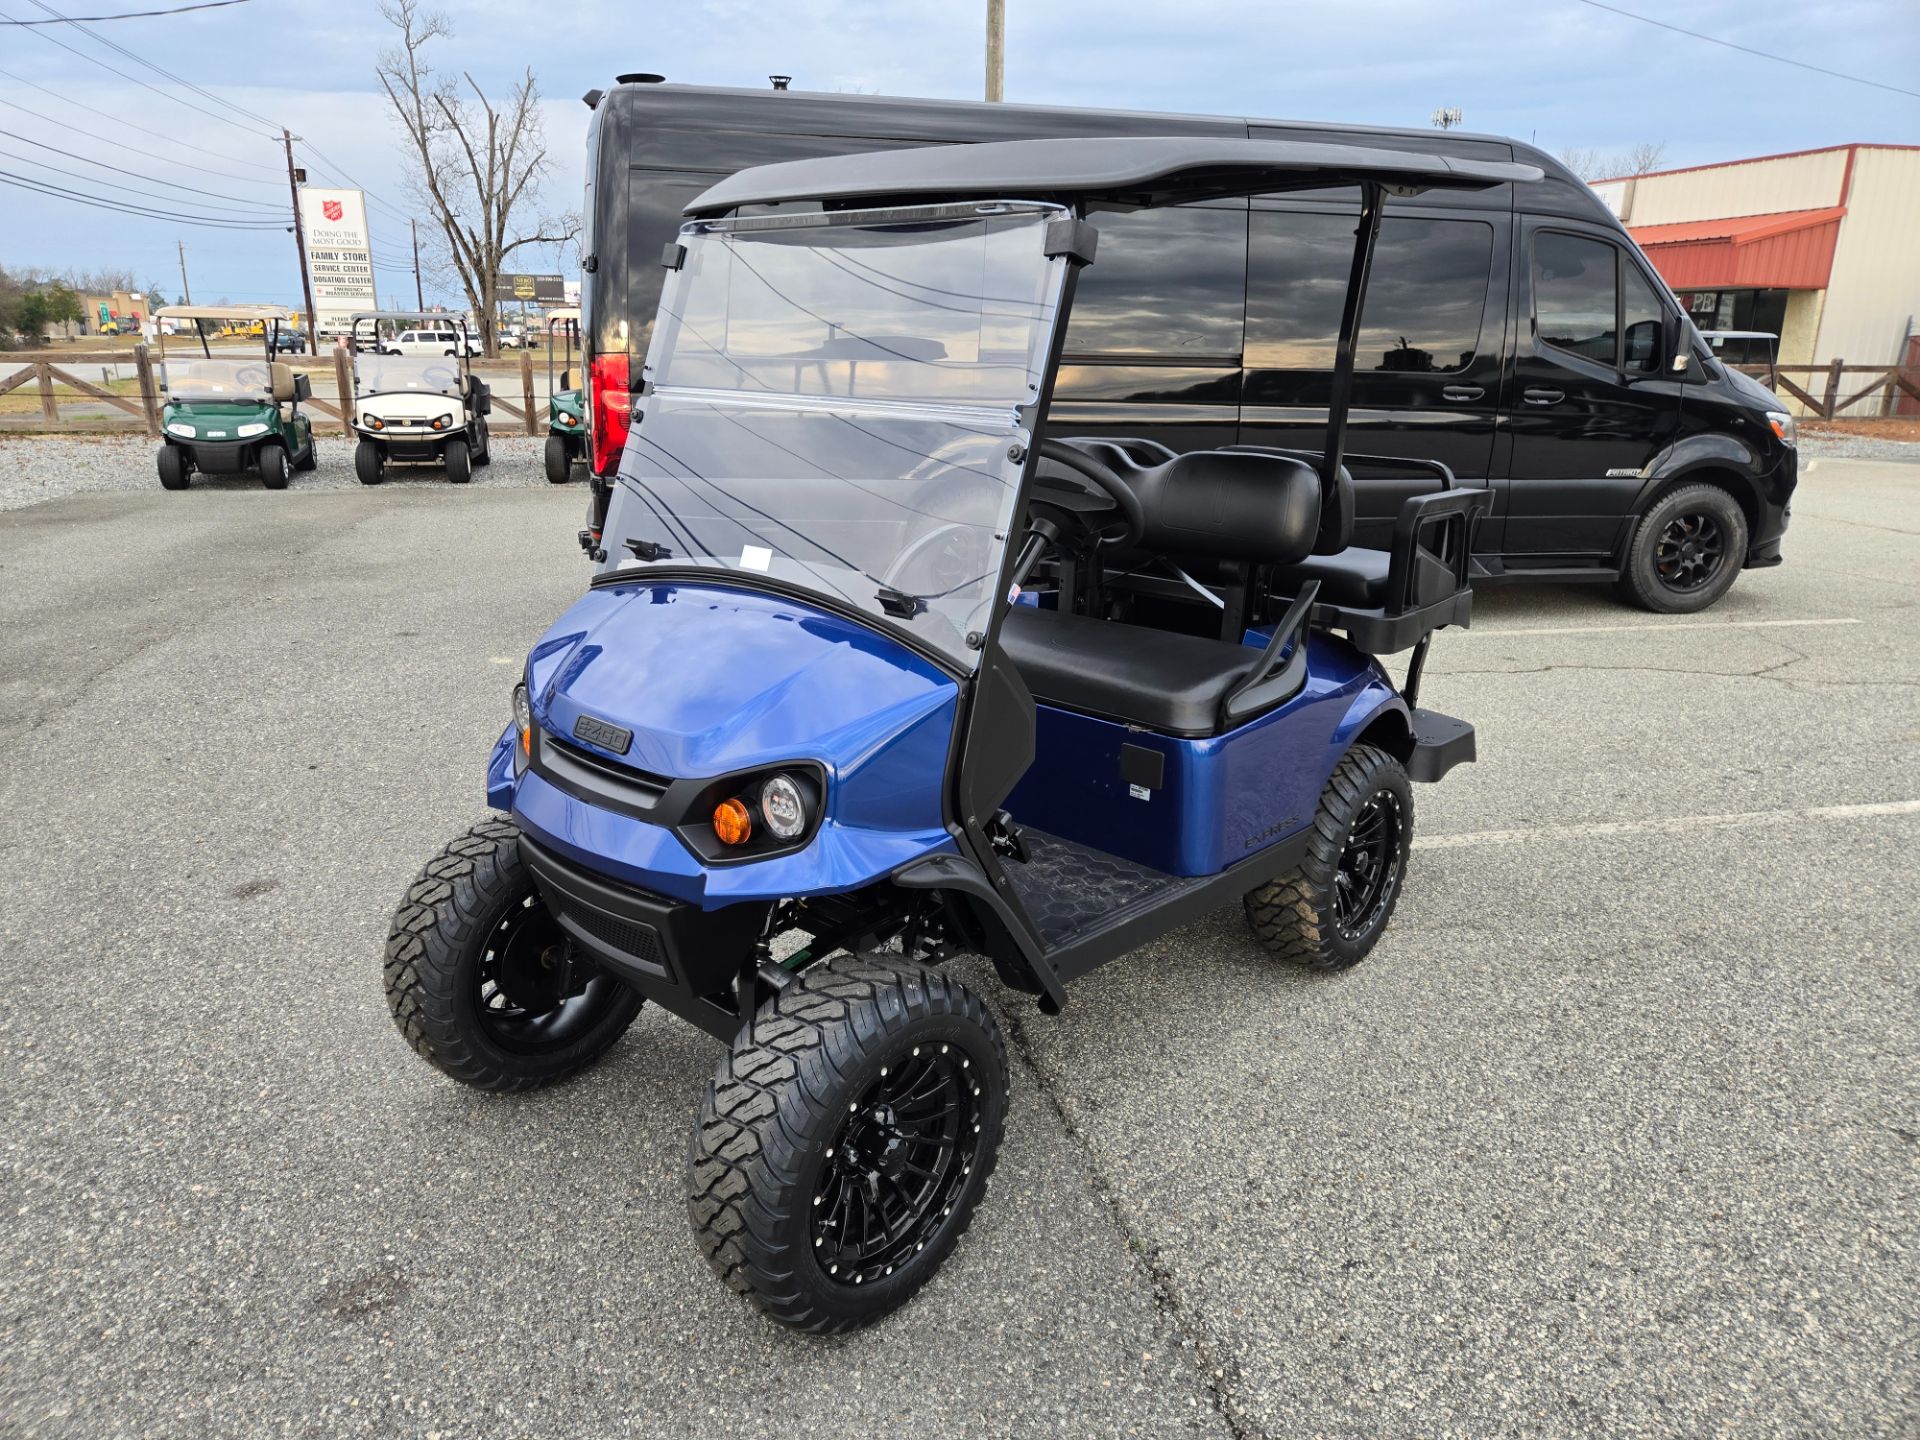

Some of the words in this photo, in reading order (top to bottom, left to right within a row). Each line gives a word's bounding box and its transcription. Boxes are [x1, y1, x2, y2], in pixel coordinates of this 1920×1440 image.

[313, 229, 341, 238] DOING
[343, 231, 359, 239] THE
[313, 238, 334, 246] MOST
[311, 251, 339, 261] FAMILY
[343, 252, 368, 262] STORE
[313, 265, 340, 273] SERVICE
[343, 265, 368, 273] CENTER
[313, 276, 346, 284] DONATION
[347, 277, 372, 285] CENTER
[1244, 814, 1301, 849] EXPRESS
